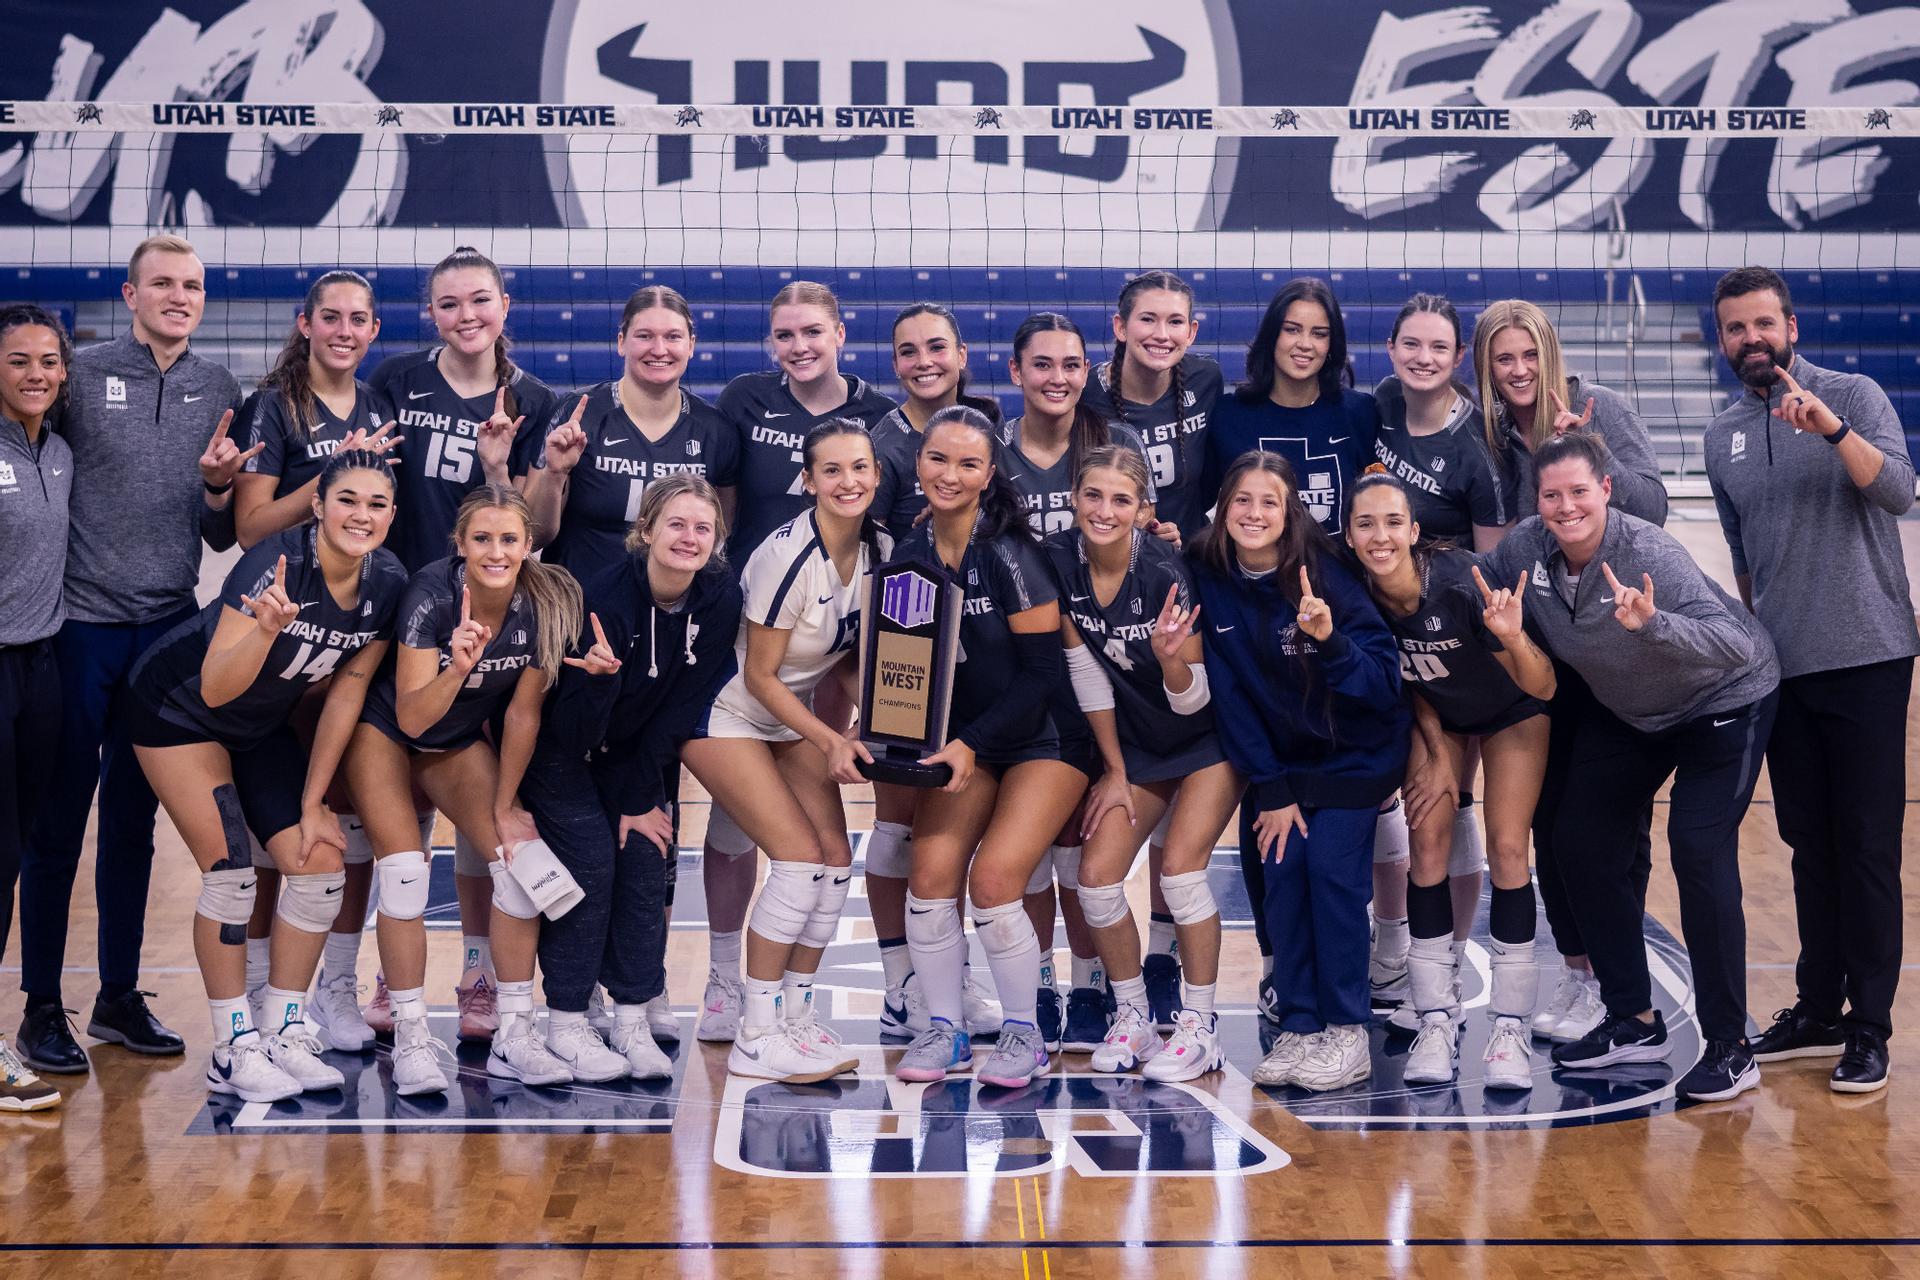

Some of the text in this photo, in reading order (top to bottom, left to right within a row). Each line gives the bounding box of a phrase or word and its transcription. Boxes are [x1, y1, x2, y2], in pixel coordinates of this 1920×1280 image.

[153, 104, 317, 126] UTAH STATE
[453, 105, 615, 127] UTAH STATE
[752, 106, 915, 129] UTAH STATE
[1051, 107, 1213, 129] UTAH STATE
[1349, 108, 1510, 130] UTAH STATE
[1646, 109, 1806, 131] UTAH STATE
[399, 408, 451, 432] UTAH
[752, 426, 805, 449] UTAH
[424, 431, 477, 484] 15
[595, 456, 647, 477] UTAH
[1396, 460, 1442, 496] STATE
[1297, 488, 1335, 505] ATE
[963, 597, 994, 617] ATE
[1103, 638, 1136, 672] 4
[1403, 638, 1462, 653] STATE
[279, 642, 343, 683] 14
[881, 660, 925, 676] MOUNTAIN
[881, 670, 924, 691] WEST
[878, 698, 922, 711] CHAMPIONS
